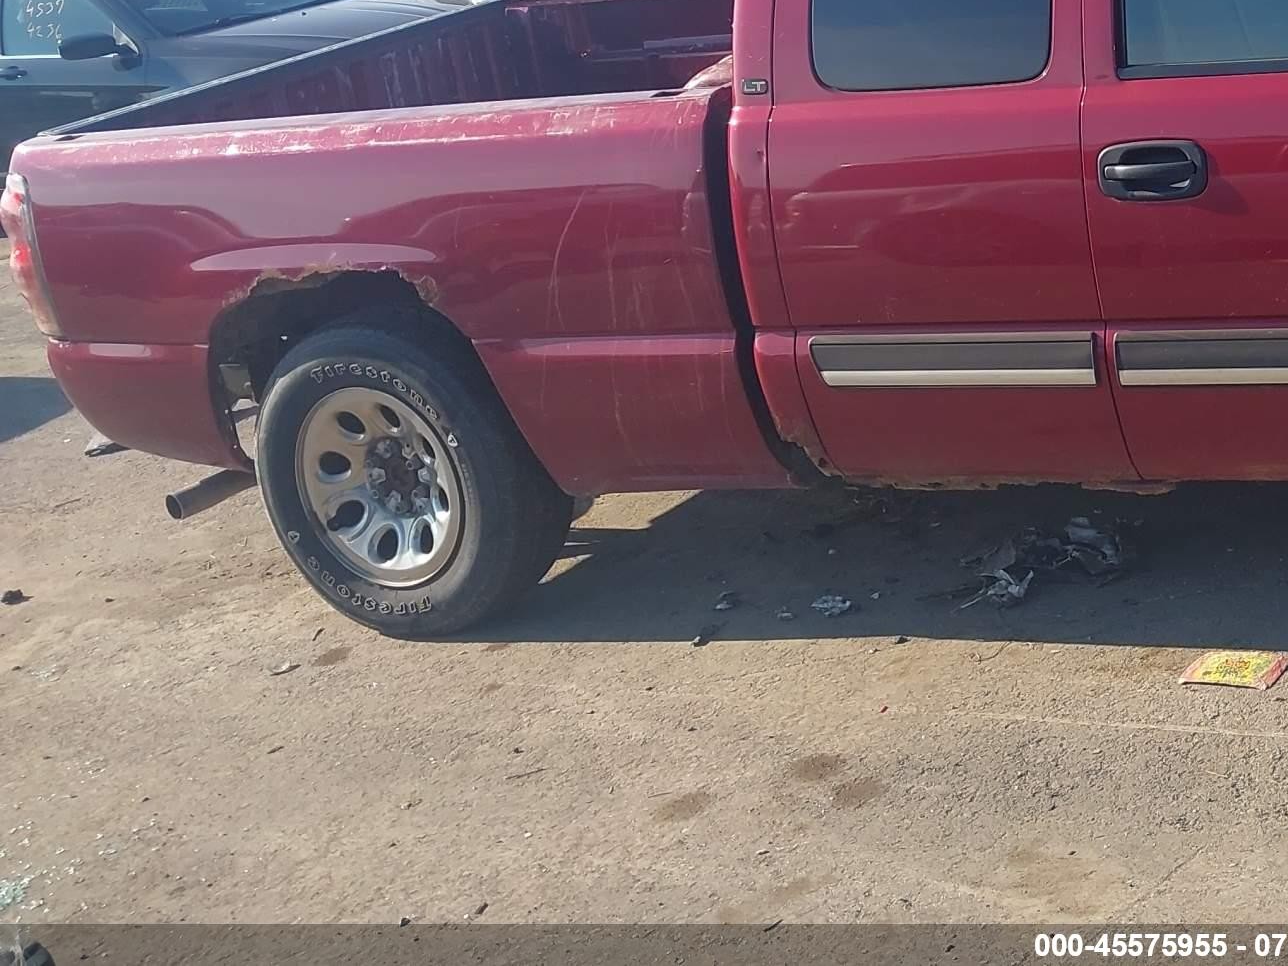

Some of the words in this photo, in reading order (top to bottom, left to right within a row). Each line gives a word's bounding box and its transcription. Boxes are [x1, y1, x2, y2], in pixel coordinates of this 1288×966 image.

[743, 80, 766, 92] LT
[310, 362, 438, 421] Firestone
[307, 555, 432, 615] Firestone
